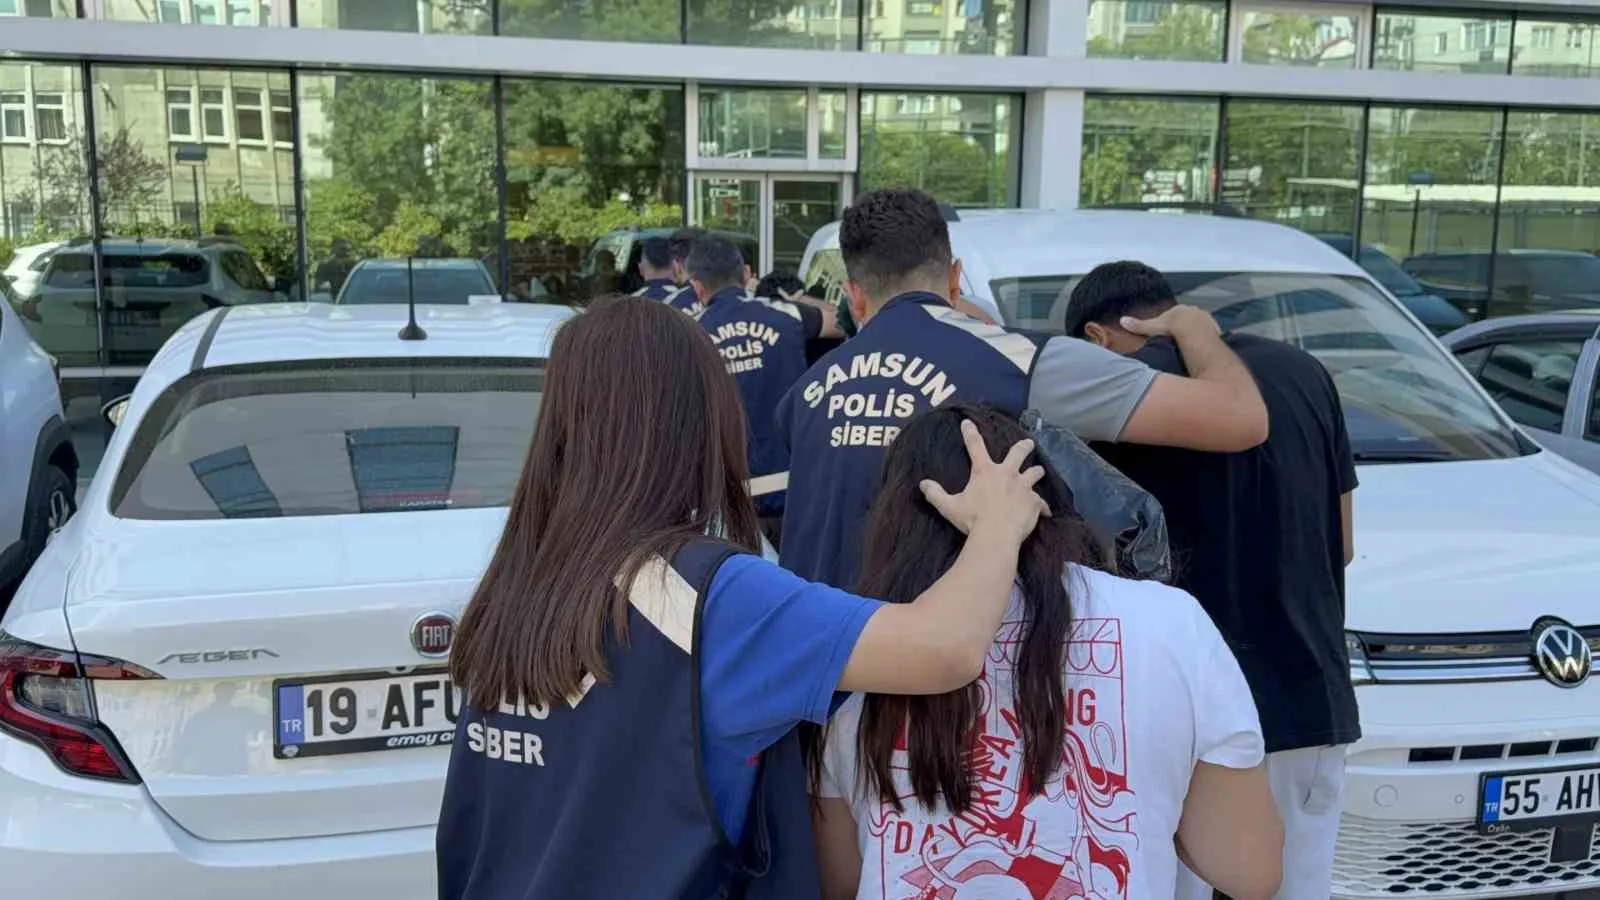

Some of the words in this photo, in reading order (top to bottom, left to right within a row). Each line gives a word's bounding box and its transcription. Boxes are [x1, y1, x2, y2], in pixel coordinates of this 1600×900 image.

[803, 352, 957, 408] SAMSUN
[827, 388, 915, 419] POLİS
[422, 625, 450, 648] FIAT
[282, 720, 302, 733] TR
[307, 688, 357, 736] 19
[467, 721, 545, 767] SBER
[1503, 778, 1541, 816] 55
[1556, 773, 1600, 811] AH
